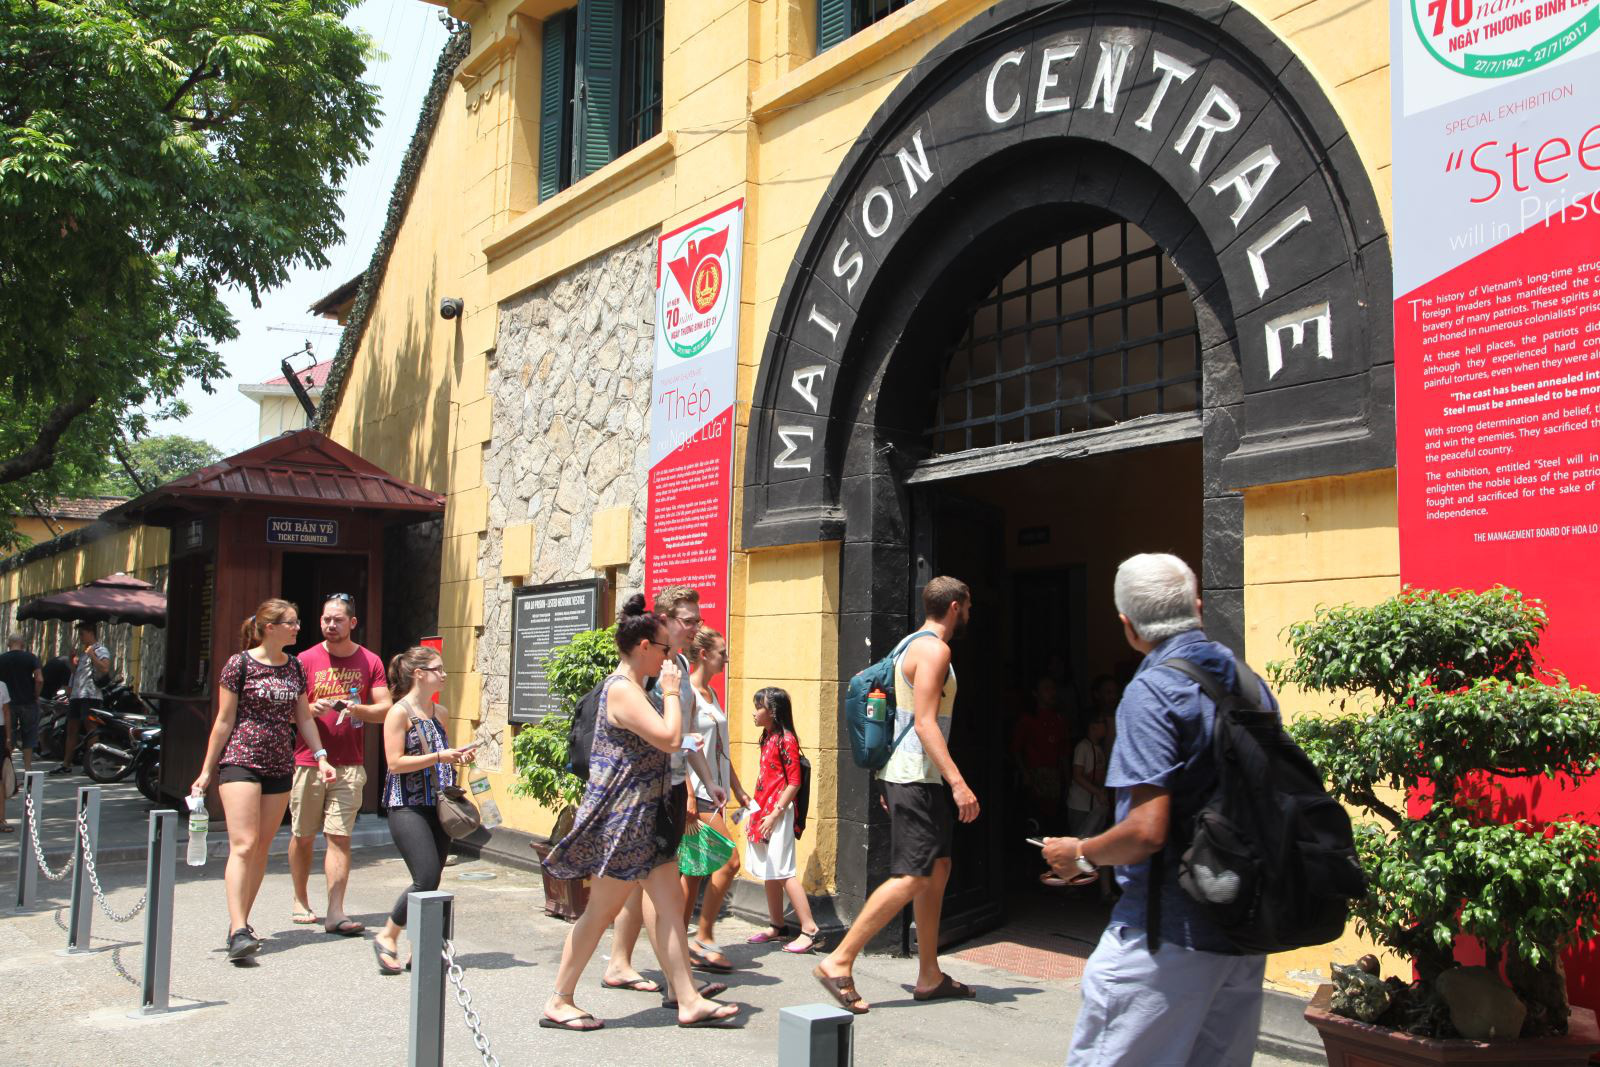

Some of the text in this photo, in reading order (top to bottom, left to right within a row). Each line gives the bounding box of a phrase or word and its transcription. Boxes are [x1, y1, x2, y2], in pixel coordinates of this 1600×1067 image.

[1428, 0, 1473, 36] 70
[1448, 0, 1566, 52] NGÀY THƯƠNG BINH
[1473, 56, 1525, 73] 27/7/1947
[1534, 22, 1587, 62] 27/7/2017
[1445, 84, 1573, 136] SPECIAL EXHIBITION
[1450, 223, 1484, 250] will
[1492, 221, 1510, 241] in
[774, 42, 1332, 473] MAISON CENTRALE
[1422, 307, 1451, 320] foreign
[1456, 299, 1491, 312] invaders
[1496, 295, 1511, 304] has
[1516, 280, 1567, 299] manifested
[1573, 278, 1589, 287] the
[1436, 292, 1465, 304] history
[1469, 286, 1478, 297] of
[1527, 268, 1573, 284] long-time
[666, 307, 679, 329] 70
[1422, 321, 1453, 333] bravery
[1455, 315, 1464, 325] of
[1467, 312, 1490, 324] many
[1493, 305, 1529, 320] patriots.
[1531, 298, 1558, 309] These
[1561, 291, 1590, 305] spirits
[1423, 334, 1438, 345] and
[1440, 328, 1467, 341] honed
[1479, 319, 1523, 334] numerous
[1437, 350, 1460, 360] these
[1465, 344, 1481, 355] hell
[1486, 340, 1516, 353] places,
[1521, 335, 1537, 345] the
[1543, 328, 1579, 342] patriots
[1585, 320, 1600, 333] did
[1424, 361, 1460, 375] although
[1467, 358, 1486, 368] they
[1492, 345, 1547, 364] experienced
[1554, 340, 1576, 352] hard
[1424, 374, 1452, 390] painful
[1454, 371, 1489, 383] tortures,
[1491, 367, 1512, 377] even
[1514, 362, 1539, 373] when
[1541, 358, 1562, 368] they
[1564, 354, 1588, 364] were
[1473, 388, 1491, 399] cast
[1493, 386, 1510, 395] has
[1511, 382, 1535, 392] been
[1537, 372, 1584, 388] annealed
[1443, 404, 1465, 416] Steel
[1467, 402, 1490, 413] must
[1491, 400, 1504, 409] be
[1505, 391, 1550, 407] annealed
[1552, 391, 1563, 400] to
[1565, 388, 1578, 397] be
[1424, 427, 1444, 437] With
[1446, 424, 1473, 434] strong
[1476, 415, 1539, 430] determination
[1542, 409, 1560, 421] and
[1563, 404, 1591, 417] belief,
[1425, 439, 1441, 450] and
[1443, 438, 1458, 447] win
[1461, 436, 1475, 445] the
[1478, 431, 1517, 443] enemies.
[1519, 428, 1540, 437] They
[1544, 419, 1588, 434] sacrificed
[1425, 446, 1513, 463] the peaceful country.
[1425, 472, 1441, 480] The
[1446, 467, 1490, 479] exhibition,
[1496, 460, 1530, 473] entitled
[1567, 454, 1583, 464] will
[1590, 453, 1599, 462] in
[1426, 483, 1465, 494] enlighten
[1468, 480, 1482, 489] the
[1486, 477, 1511, 487] noble
[1514, 475, 1537, 484] ideas
[1540, 471, 1550, 482] of
[1553, 471, 1569, 480] the
[1426, 480, 1595, 507] fought and sacrificed for the sake of
[272, 521, 334, 533] NƠI BÁN VÉ
[1426, 508, 1488, 520] independence.
[278, 533, 299, 542] TICKET
[1474, 523, 1598, 542] THE MANAGEMENT BOARD OF HOA LO
